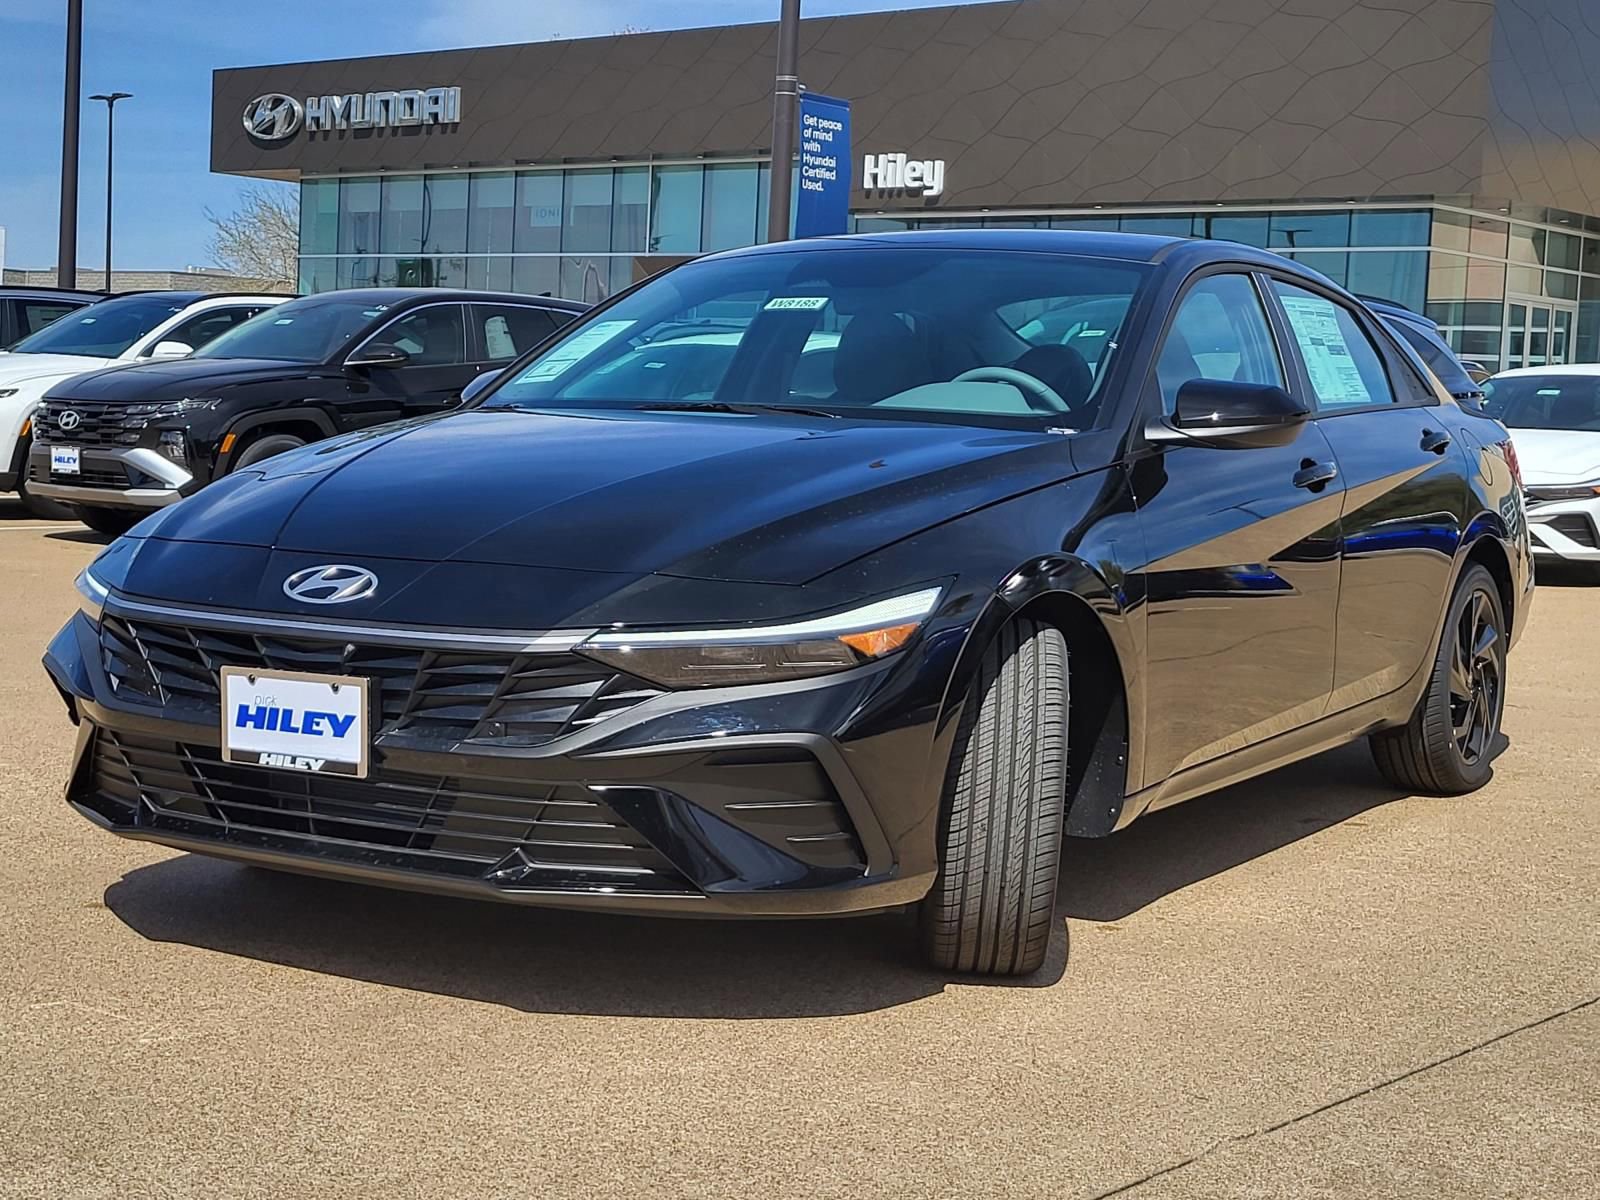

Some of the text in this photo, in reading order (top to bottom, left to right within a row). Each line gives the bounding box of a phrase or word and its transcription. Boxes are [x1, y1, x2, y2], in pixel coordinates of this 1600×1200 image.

[306, 87, 461, 131] HYUNDAI
[803, 114, 842, 131] Get peace
[803, 128, 833, 141] of mind
[803, 140, 821, 152] with
[803, 153, 837, 167] Hyundai
[802, 166, 836, 180] Certified
[864, 153, 945, 196] Hiley
[802, 179, 824, 191] Used.
[535, 208, 561, 218] IONI
[54, 456, 77, 464] HILEY
[235, 704, 357, 738] HILEY
[258, 753, 326, 771] HILEY
